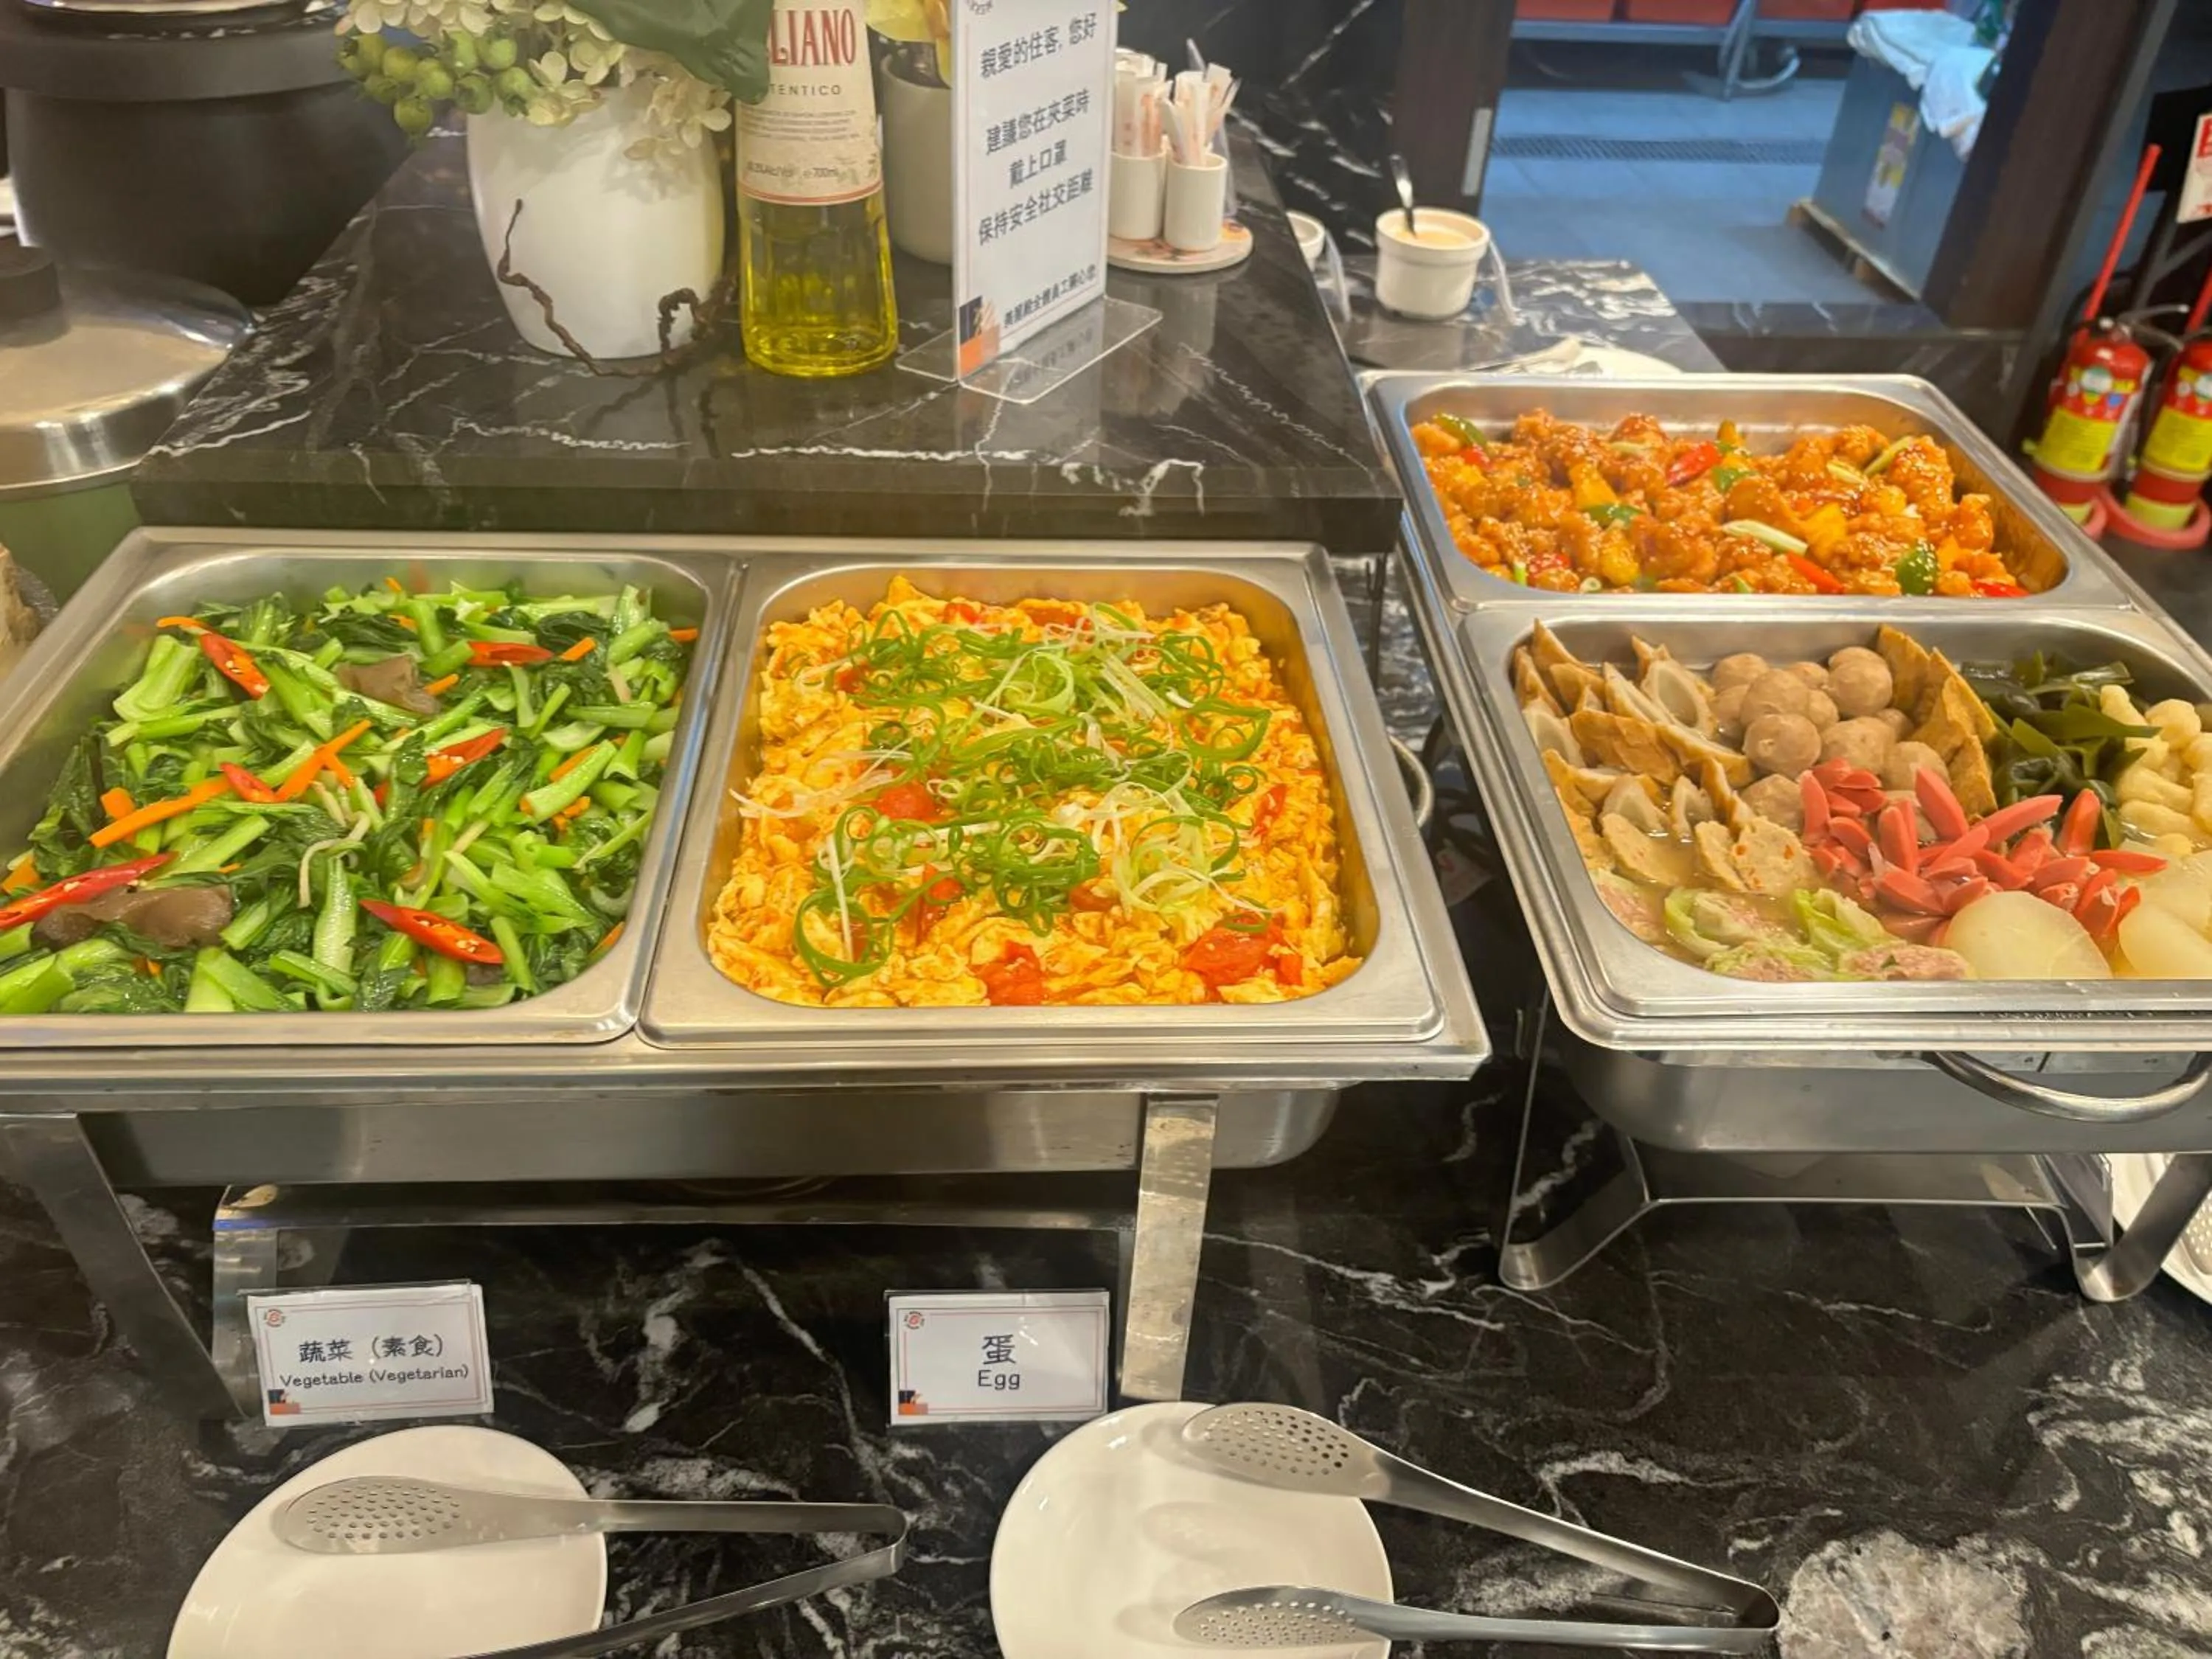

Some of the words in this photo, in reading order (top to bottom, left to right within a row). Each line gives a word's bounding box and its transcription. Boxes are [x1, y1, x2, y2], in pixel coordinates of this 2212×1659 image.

[1009, 139, 1067, 189] 戴上口罩
[978, 168, 1093, 246] 保持安全社交距離
[981, 1334, 1016, 1365] 蛋
[279, 1371, 363, 1388] Vegetable
[369, 1364, 469, 1384] (Vegetarian)
[978, 1369, 1020, 1391] Egg
